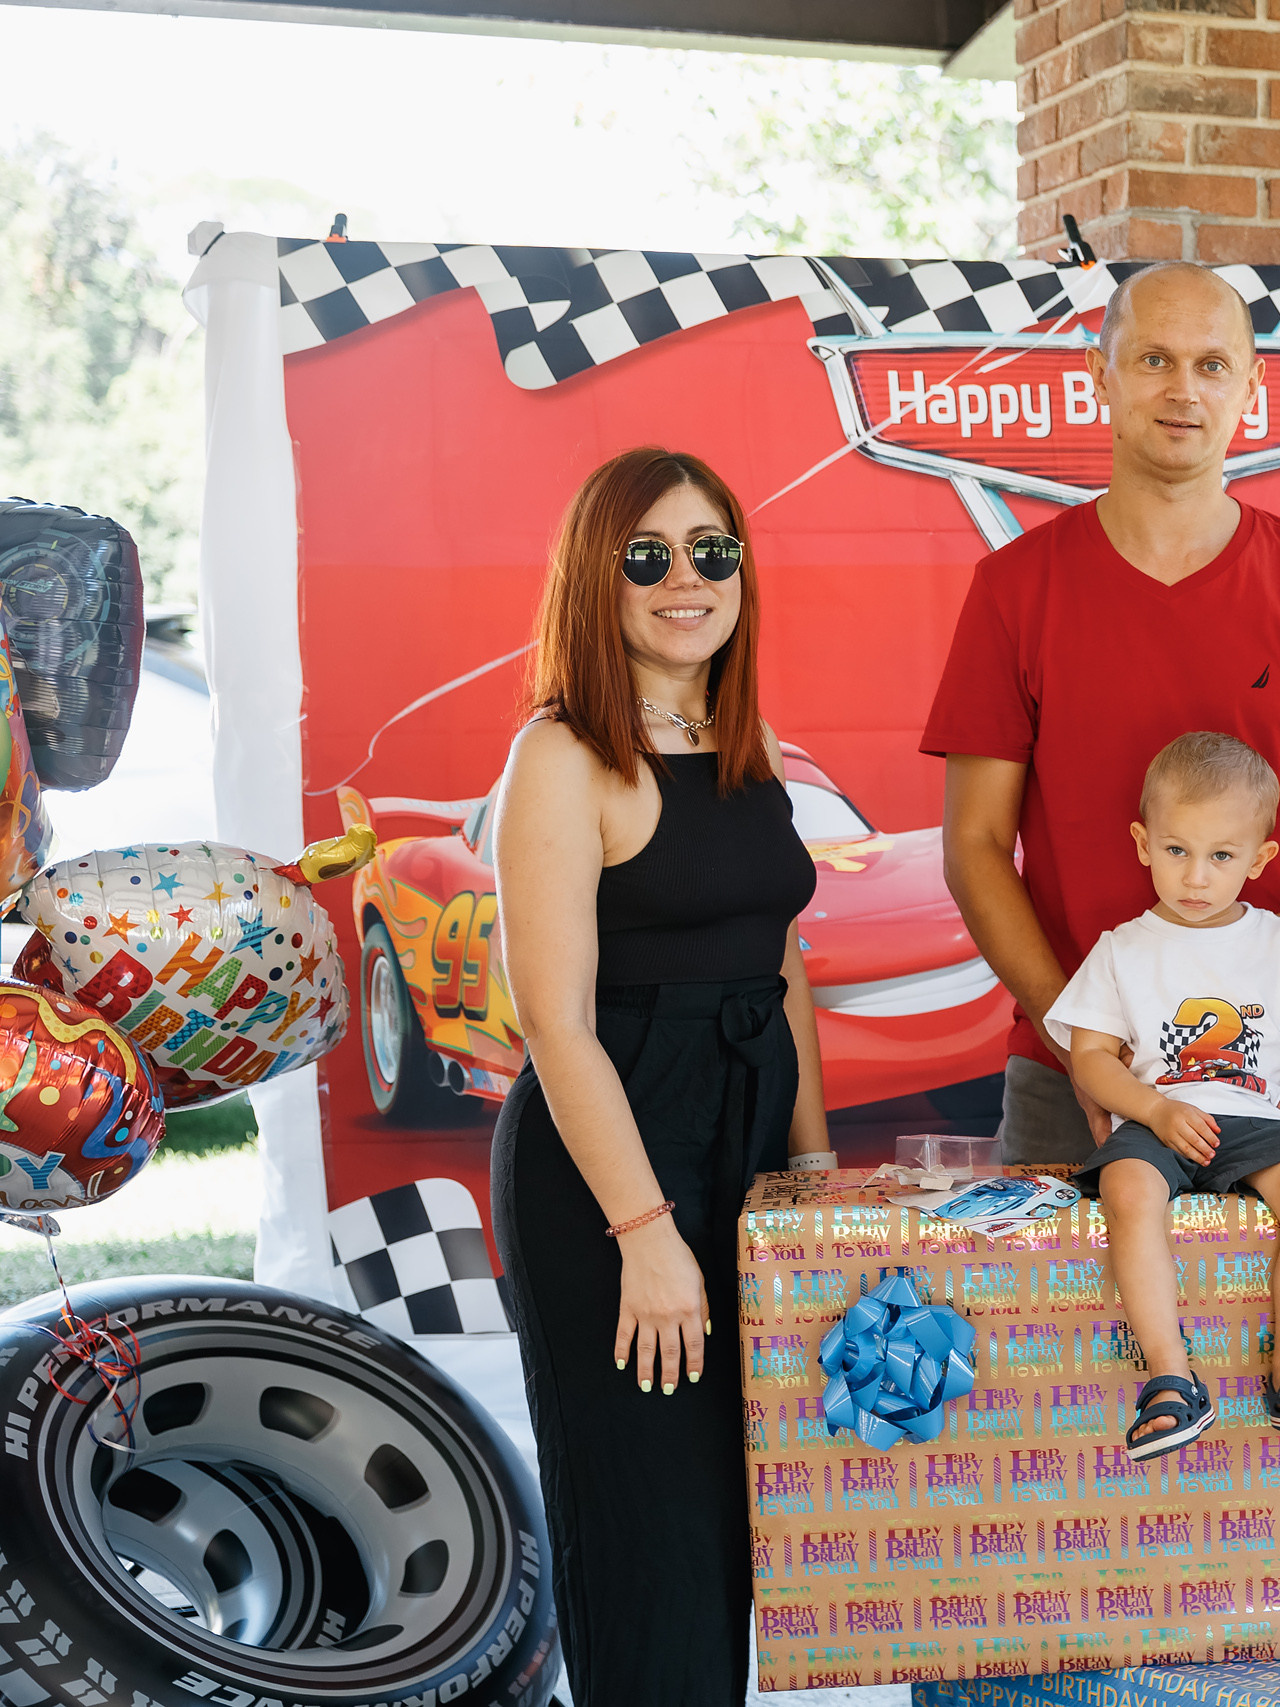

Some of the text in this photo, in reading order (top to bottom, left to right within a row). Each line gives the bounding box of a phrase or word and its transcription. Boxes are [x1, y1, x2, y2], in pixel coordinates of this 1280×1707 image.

[887, 370, 1052, 439] Happy
[155, 931, 317, 1043] HAPPY
[432, 890, 498, 1021] 95
[74, 948, 302, 1086] BIRTHDAY
[5, 1412, 31, 1460] HI
